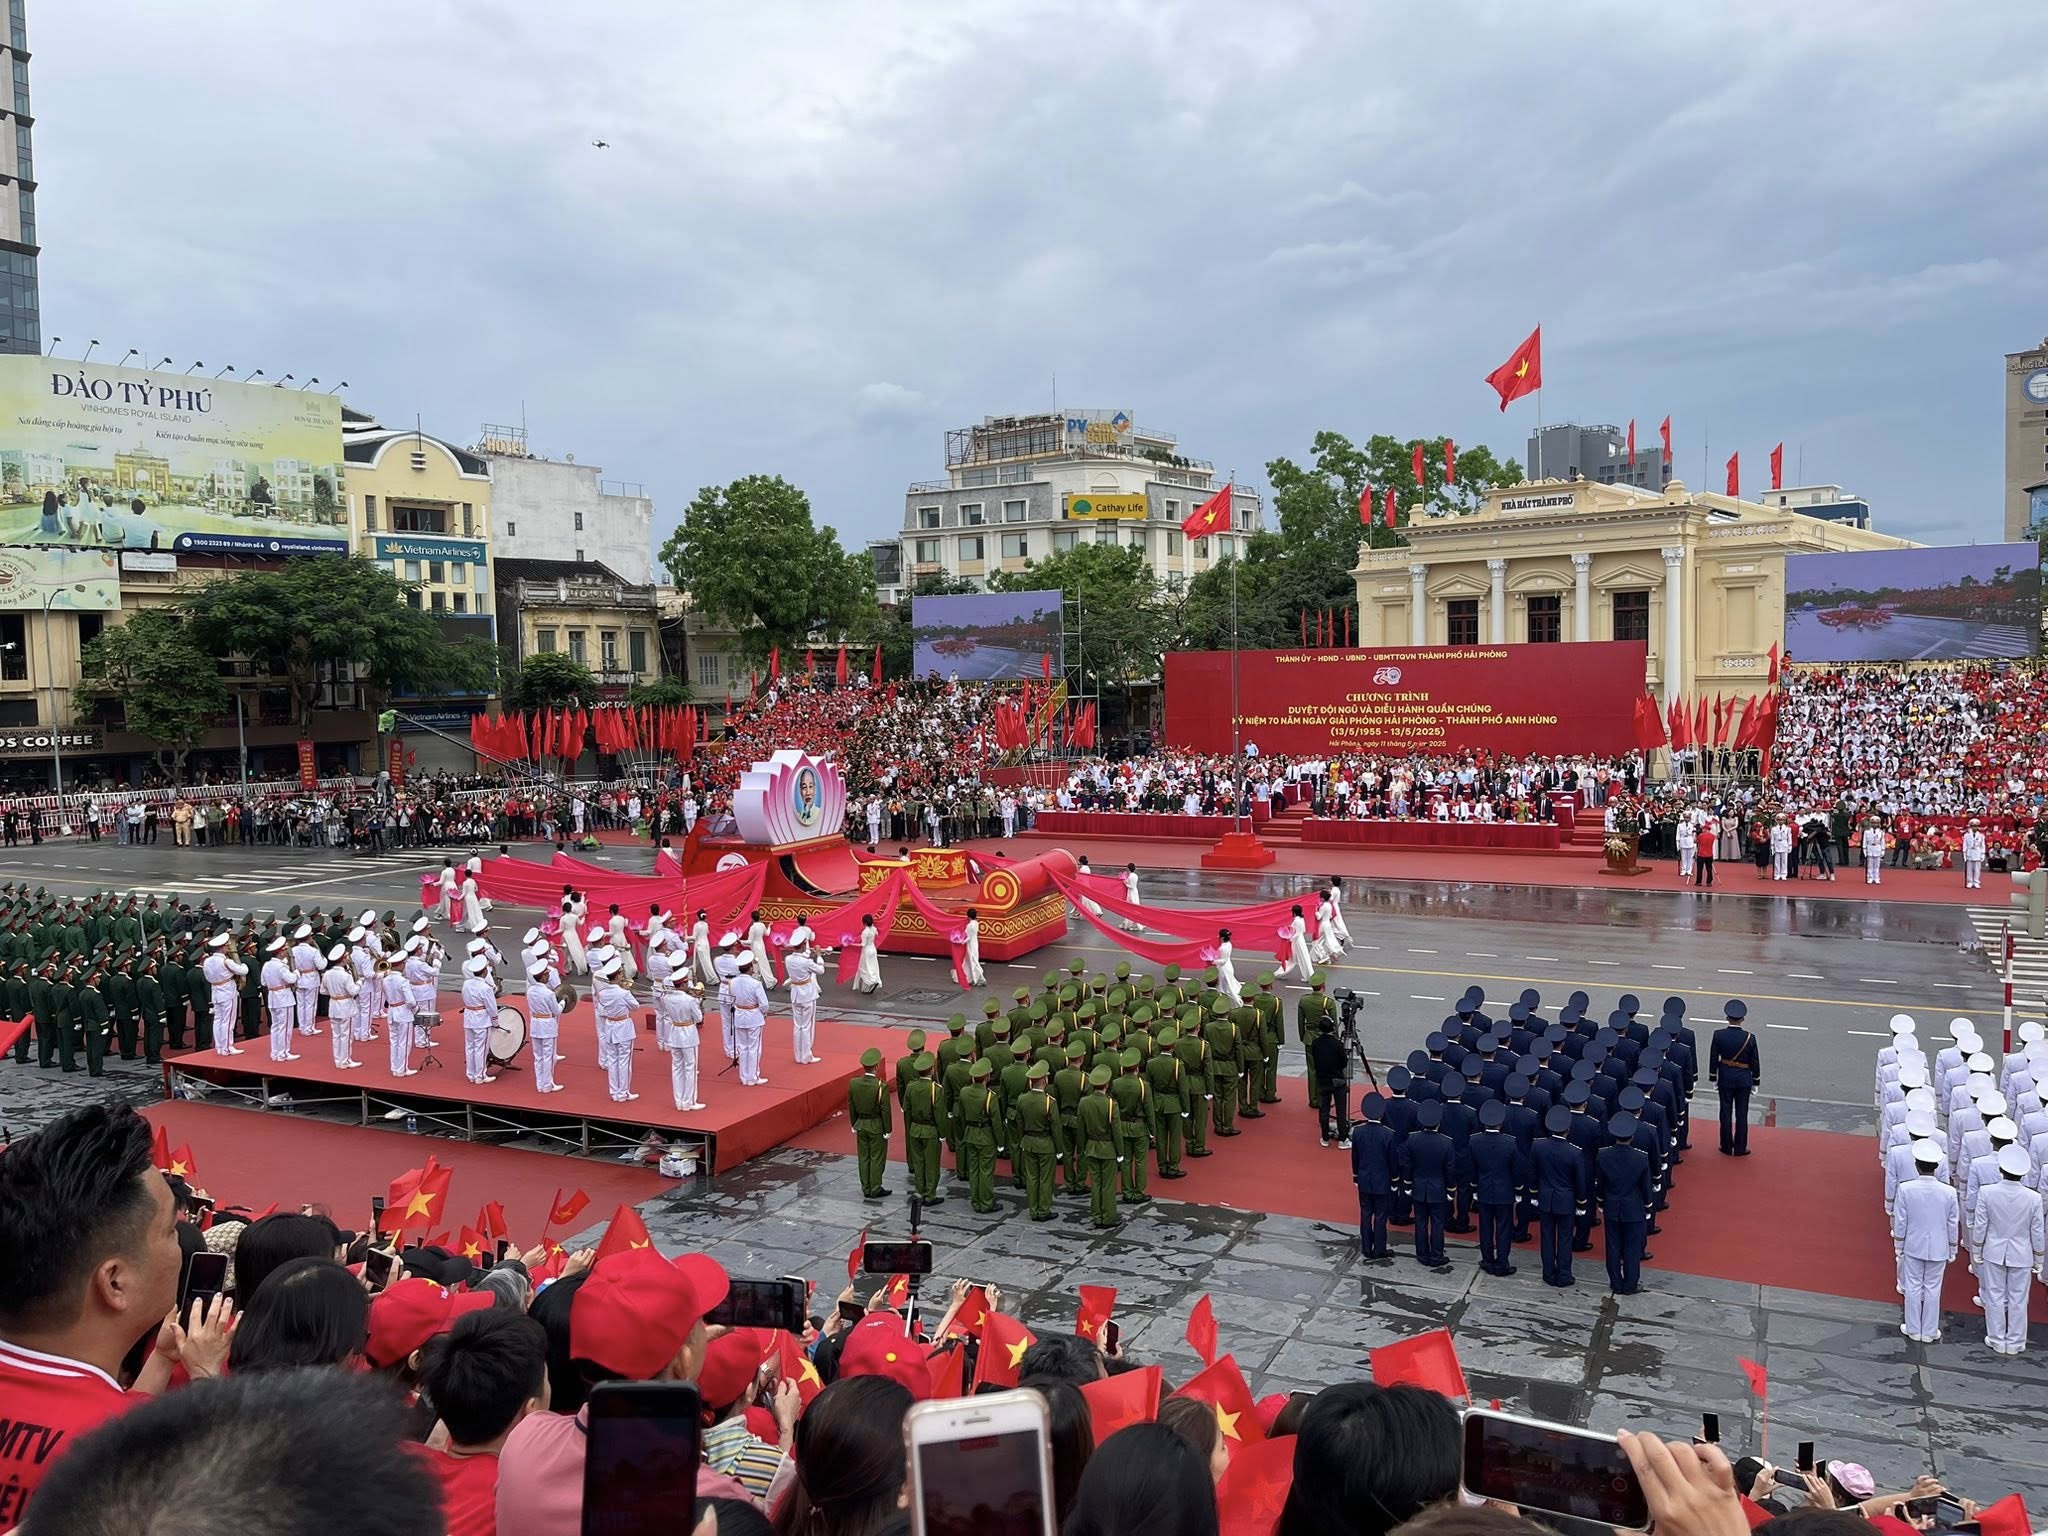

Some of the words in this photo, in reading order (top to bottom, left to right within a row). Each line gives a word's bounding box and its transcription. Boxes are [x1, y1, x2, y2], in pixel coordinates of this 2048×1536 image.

[50, 370, 113, 401] ĐẢO
[117, 378, 154, 406] TỶ
[159, 388, 213, 413] PHÚ
[80, 403, 130, 417] VINHOMES
[131, 409, 159, 420] ROYAL
[160, 413, 192, 424] ISLAND
[67, 420, 90, 432] hoàng
[1087, 432, 1117, 444] Bank
[1096, 503, 1126, 514] Cathay
[1127, 503, 1144, 512] Life
[1501, 499, 1517, 511] NHÀ
[1517, 498, 1532, 509] HÁT
[1532, 496, 1557, 508] THÀNH
[1557, 493, 1574, 506] PHỐ
[1275, 654, 1300, 663] THÀNH
[1301, 653, 1312, 663] ỦY
[1373, 653, 1417, 661] UBMTTQVN
[1418, 651, 1445, 660] THÀNH
[1446, 649, 1463, 659] PHỐ
[1464, 649, 1478, 659] HẢI
[1479, 649, 1508, 659] PHÒNG
[1346, 692, 1392, 702] CHƯƠNG
[1394, 690, 1429, 701] TRÌNH
[1288, 705, 1319, 716] DUYỆT
[1320, 704, 1337, 716] ĐỘI
[1338, 704, 1358, 714] NGŨ
[1360, 704, 1373, 714] VÀ
[1374, 702, 1396, 714] DIỄU
[1398, 703, 1425, 714] HÀNH
[1456, 702, 1492, 713] CHÚNG
[1245, 715, 1267, 727] NIỆM
[1268, 717, 1279, 725] 70
[1280, 715, 1301, 725] NĂM
[1302, 715, 1328, 725] NGÀY
[1329, 714, 1348, 725] GIẢI
[1350, 715, 1385, 725] PHÓNG
[1386, 714, 1401, 725] HẢI
[1402, 714, 1437, 725] PHÒNG
[1445, 713, 1480, 724] THÀNH
[1482, 712, 1503, 724] PHỐ
[1504, 716, 1527, 724] ANH
[1528, 713, 1558, 724] HÙNG
[1330, 727, 1382, 737] (13/5/1955
[1390, 726, 1445, 737] 13/5/2025)
[23, 735, 93, 747] COFFEE
[1387, 740, 1406, 748] tháng
[0, 1418, 65, 1465] MTV
